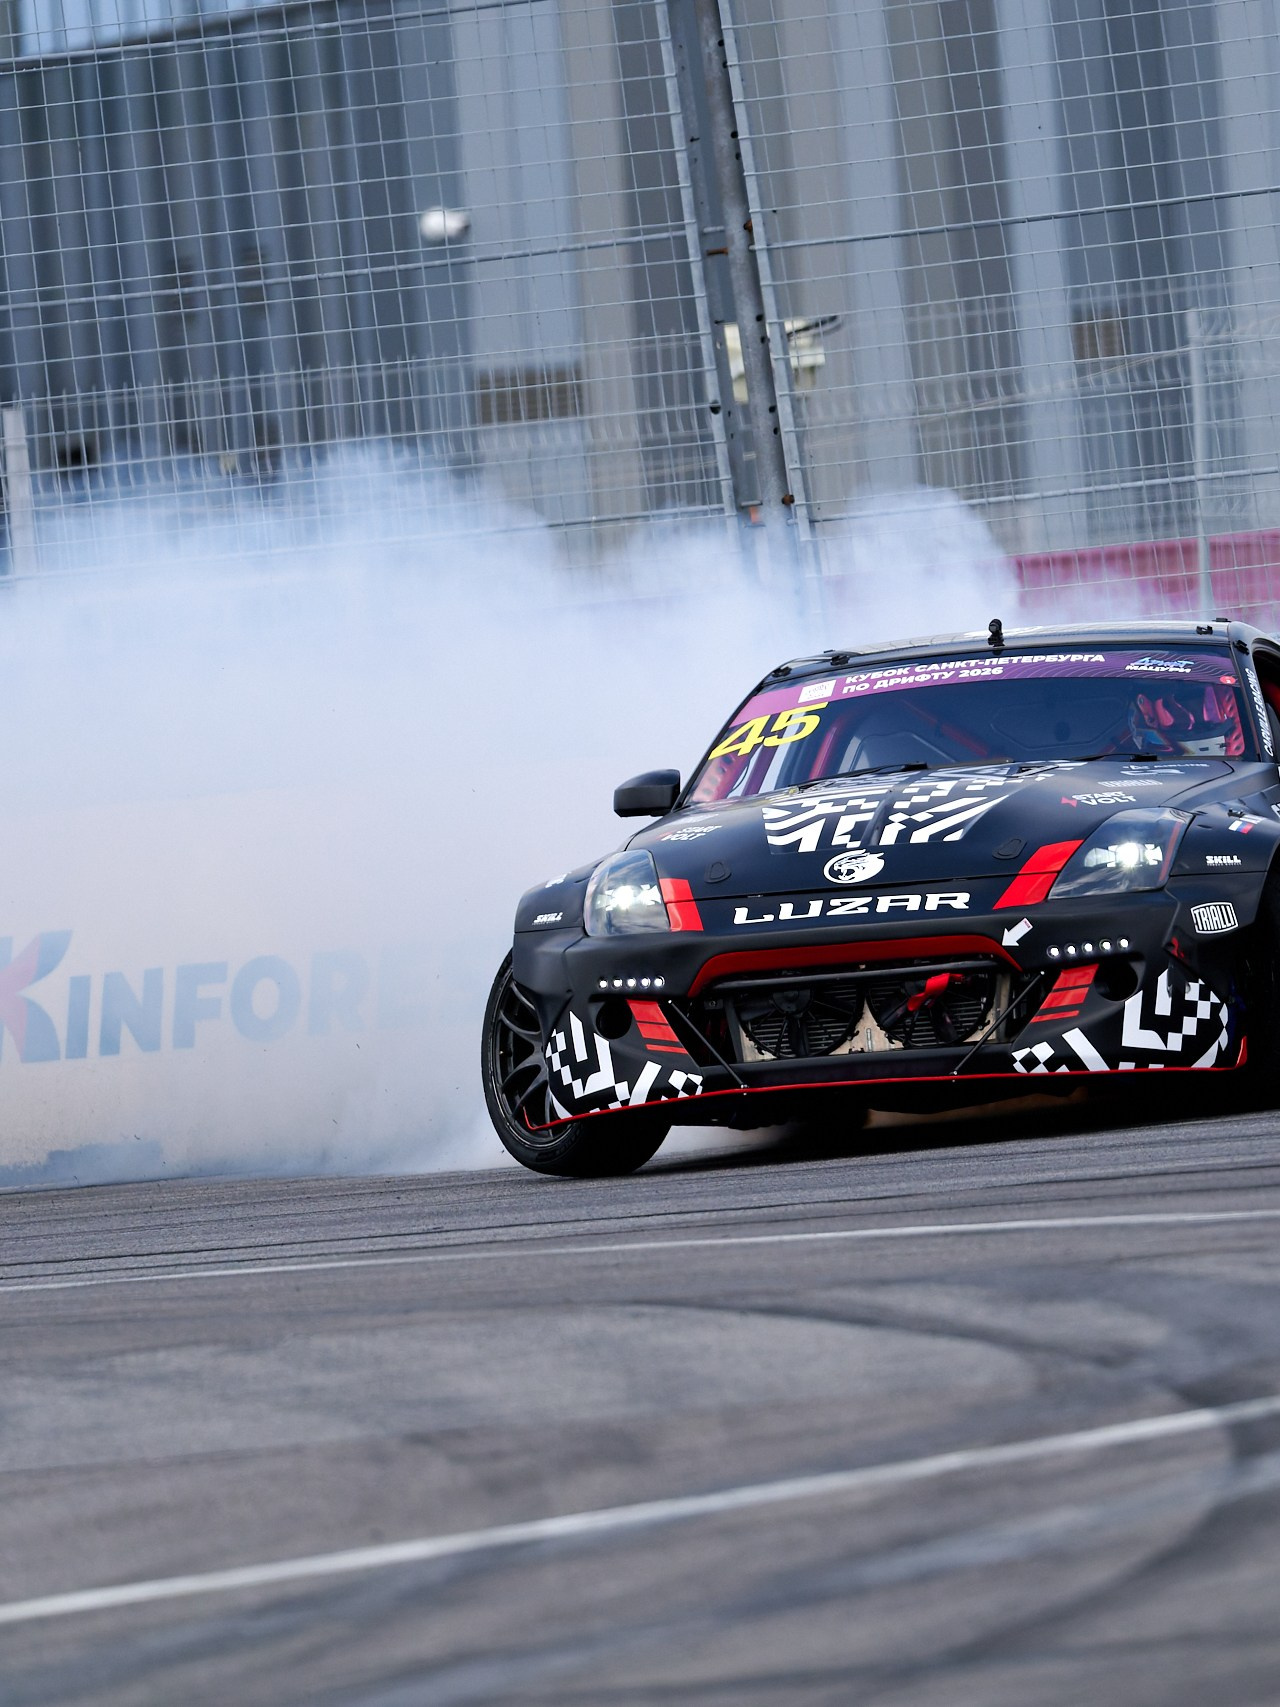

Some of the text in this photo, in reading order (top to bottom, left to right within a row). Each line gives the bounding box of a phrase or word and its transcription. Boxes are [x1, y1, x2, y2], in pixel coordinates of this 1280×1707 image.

[842, 681, 870, 694] ПО
[872, 671, 955, 689] ДРИФТУ
[957, 666, 1004, 678] 2026
[845, 654, 1105, 685] КУБОК САНКТ-ПЕТЕРБУРГА
[708, 701, 829, 760] 45
[1071, 791, 1127, 800] START
[1080, 795, 1137, 806] VOLT
[1206, 855, 1241, 864] SKILL
[734, 892, 970, 924] LUZAR
[1193, 904, 1236, 932] TRIALLI
